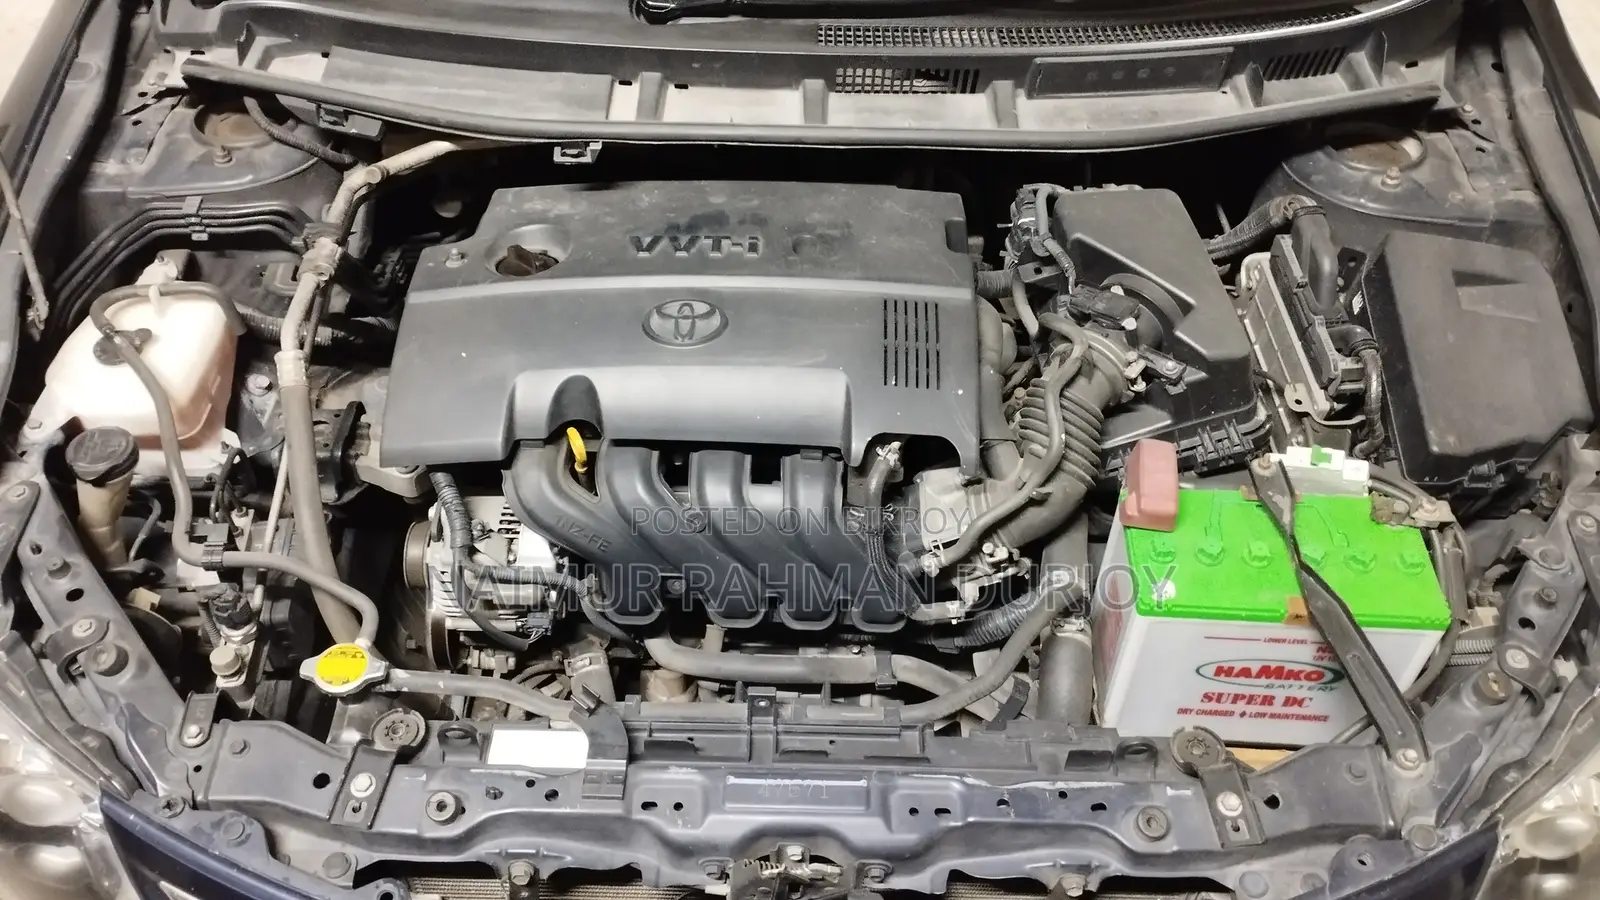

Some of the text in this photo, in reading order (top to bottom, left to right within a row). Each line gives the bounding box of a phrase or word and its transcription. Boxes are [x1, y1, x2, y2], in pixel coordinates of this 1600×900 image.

[629, 234, 762, 257] VVT-i
[1213, 665, 1325, 682] HAMKO
[1263, 683, 1338, 692] BATTERY
[1200, 691, 1313, 709] SUPER DC
[1195, 708, 1235, 717] CHARGED
[1248, 711, 1267, 719] LOW
[1268, 712, 1330, 722] MAINTENANCE
